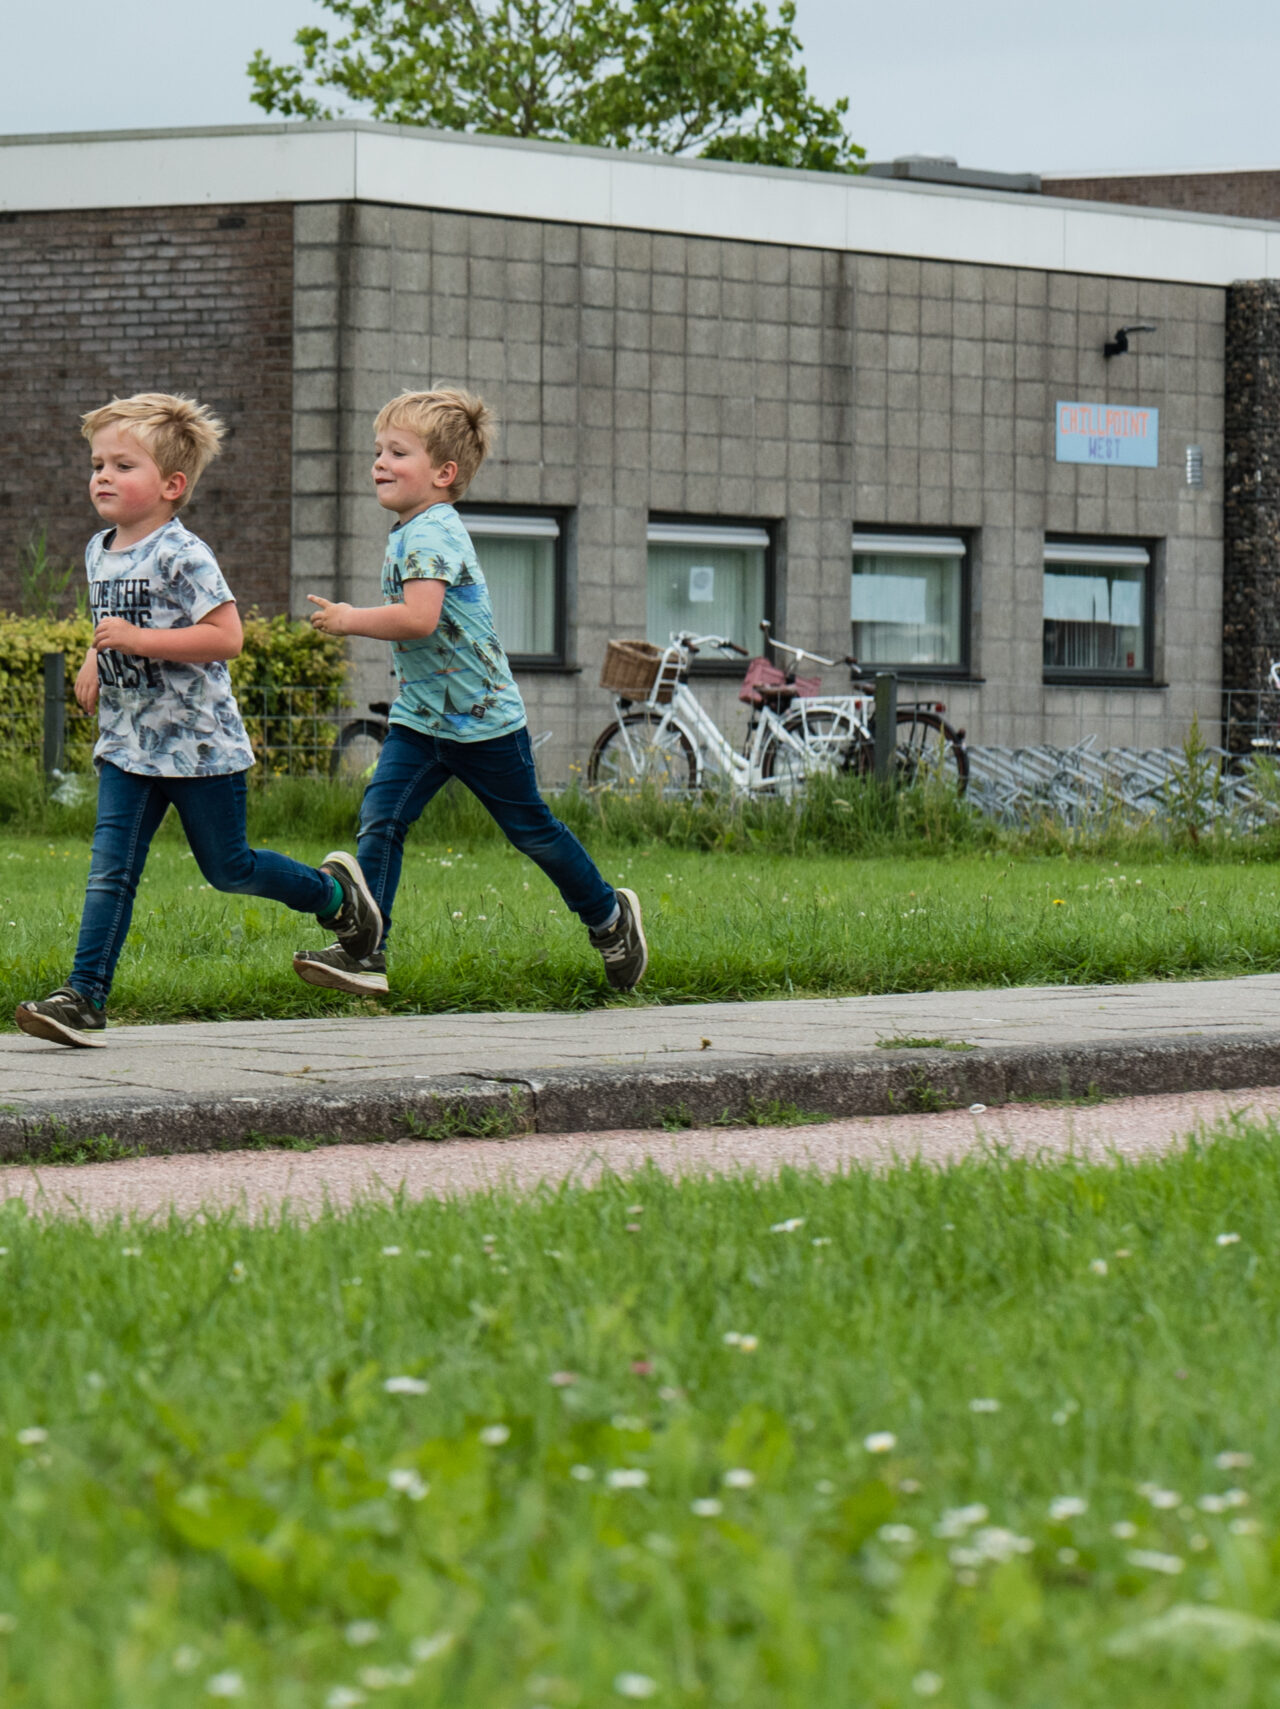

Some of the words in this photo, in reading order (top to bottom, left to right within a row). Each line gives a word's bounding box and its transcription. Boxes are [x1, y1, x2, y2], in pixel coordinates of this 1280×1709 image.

[1060, 407, 1149, 437] CHILLPOINT
[1089, 437, 1120, 459] WEST
[114, 579, 151, 607] THE
[97, 649, 158, 689] OAST
